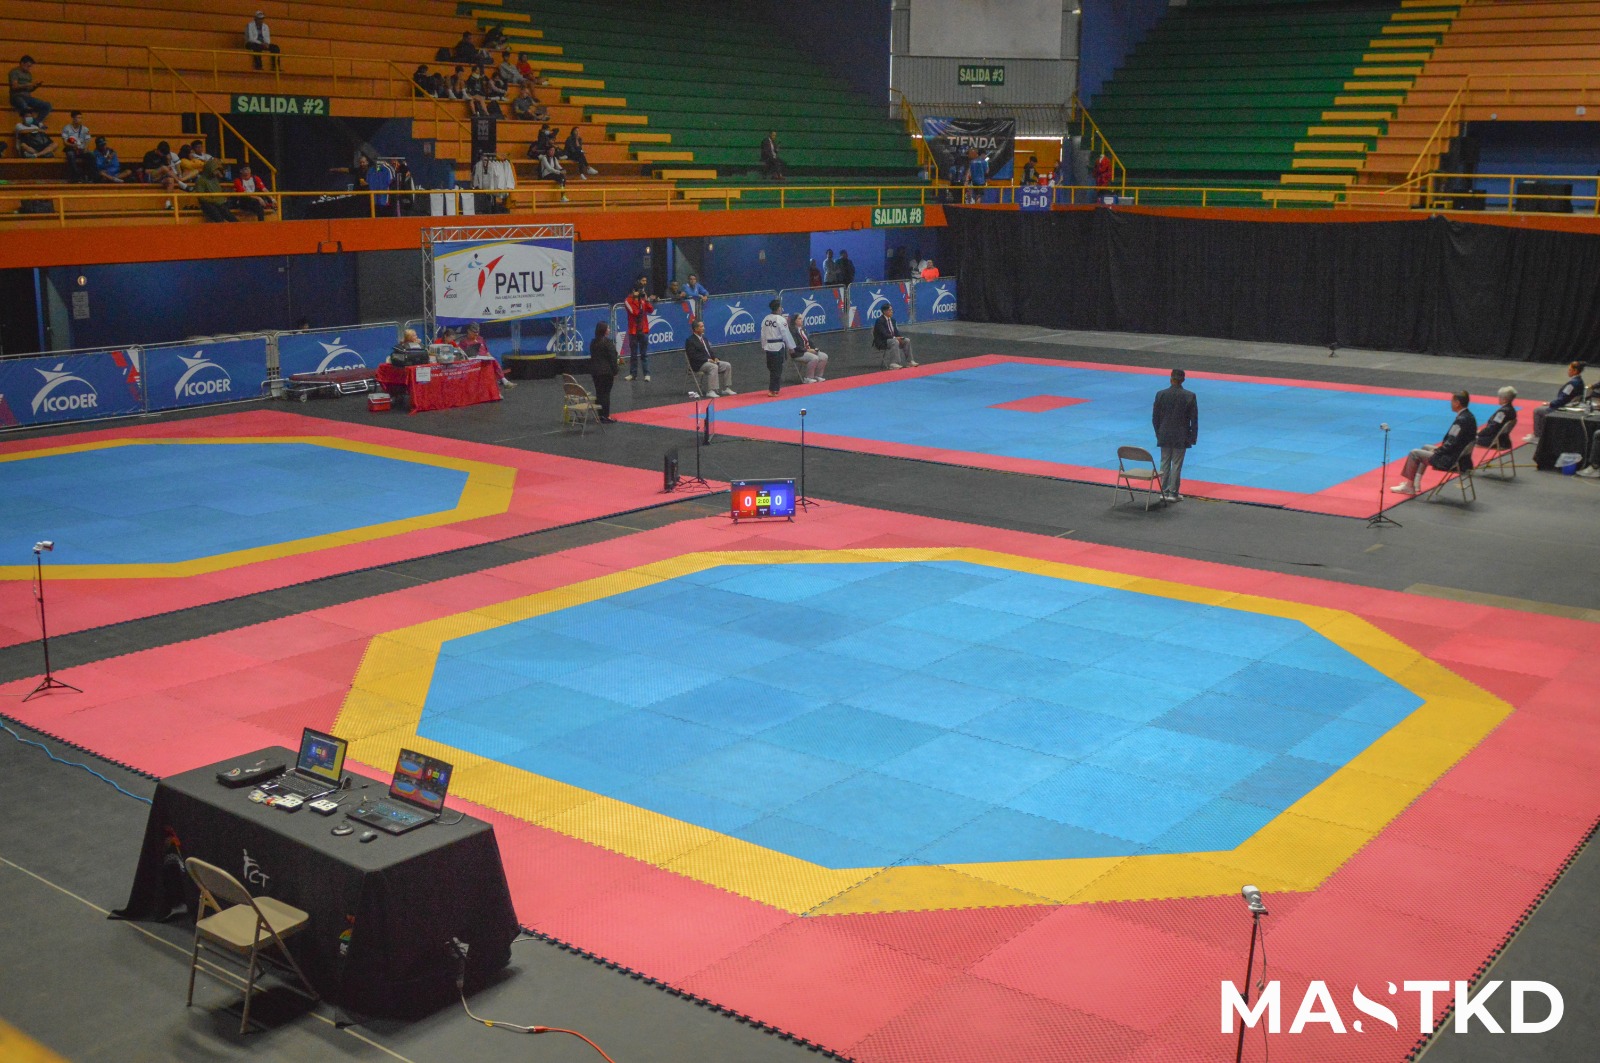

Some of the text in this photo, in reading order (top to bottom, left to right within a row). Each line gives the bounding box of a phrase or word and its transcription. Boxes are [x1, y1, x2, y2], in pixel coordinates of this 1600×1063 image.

[960, 68, 1004, 82] SALIDA #3
[237, 95, 324, 114] SALIDA #2
[947, 136, 997, 149] TIENDA
[874, 208, 922, 225] SALIDA #8
[495, 270, 544, 295] PATU
[729, 322, 756, 336] ICODER
[648, 331, 674, 345] CODER
[185, 378, 232, 397] ICODER
[43, 393, 98, 412] ICODER
[745, 496, 752, 506] 0
[775, 495, 782, 505] 0
